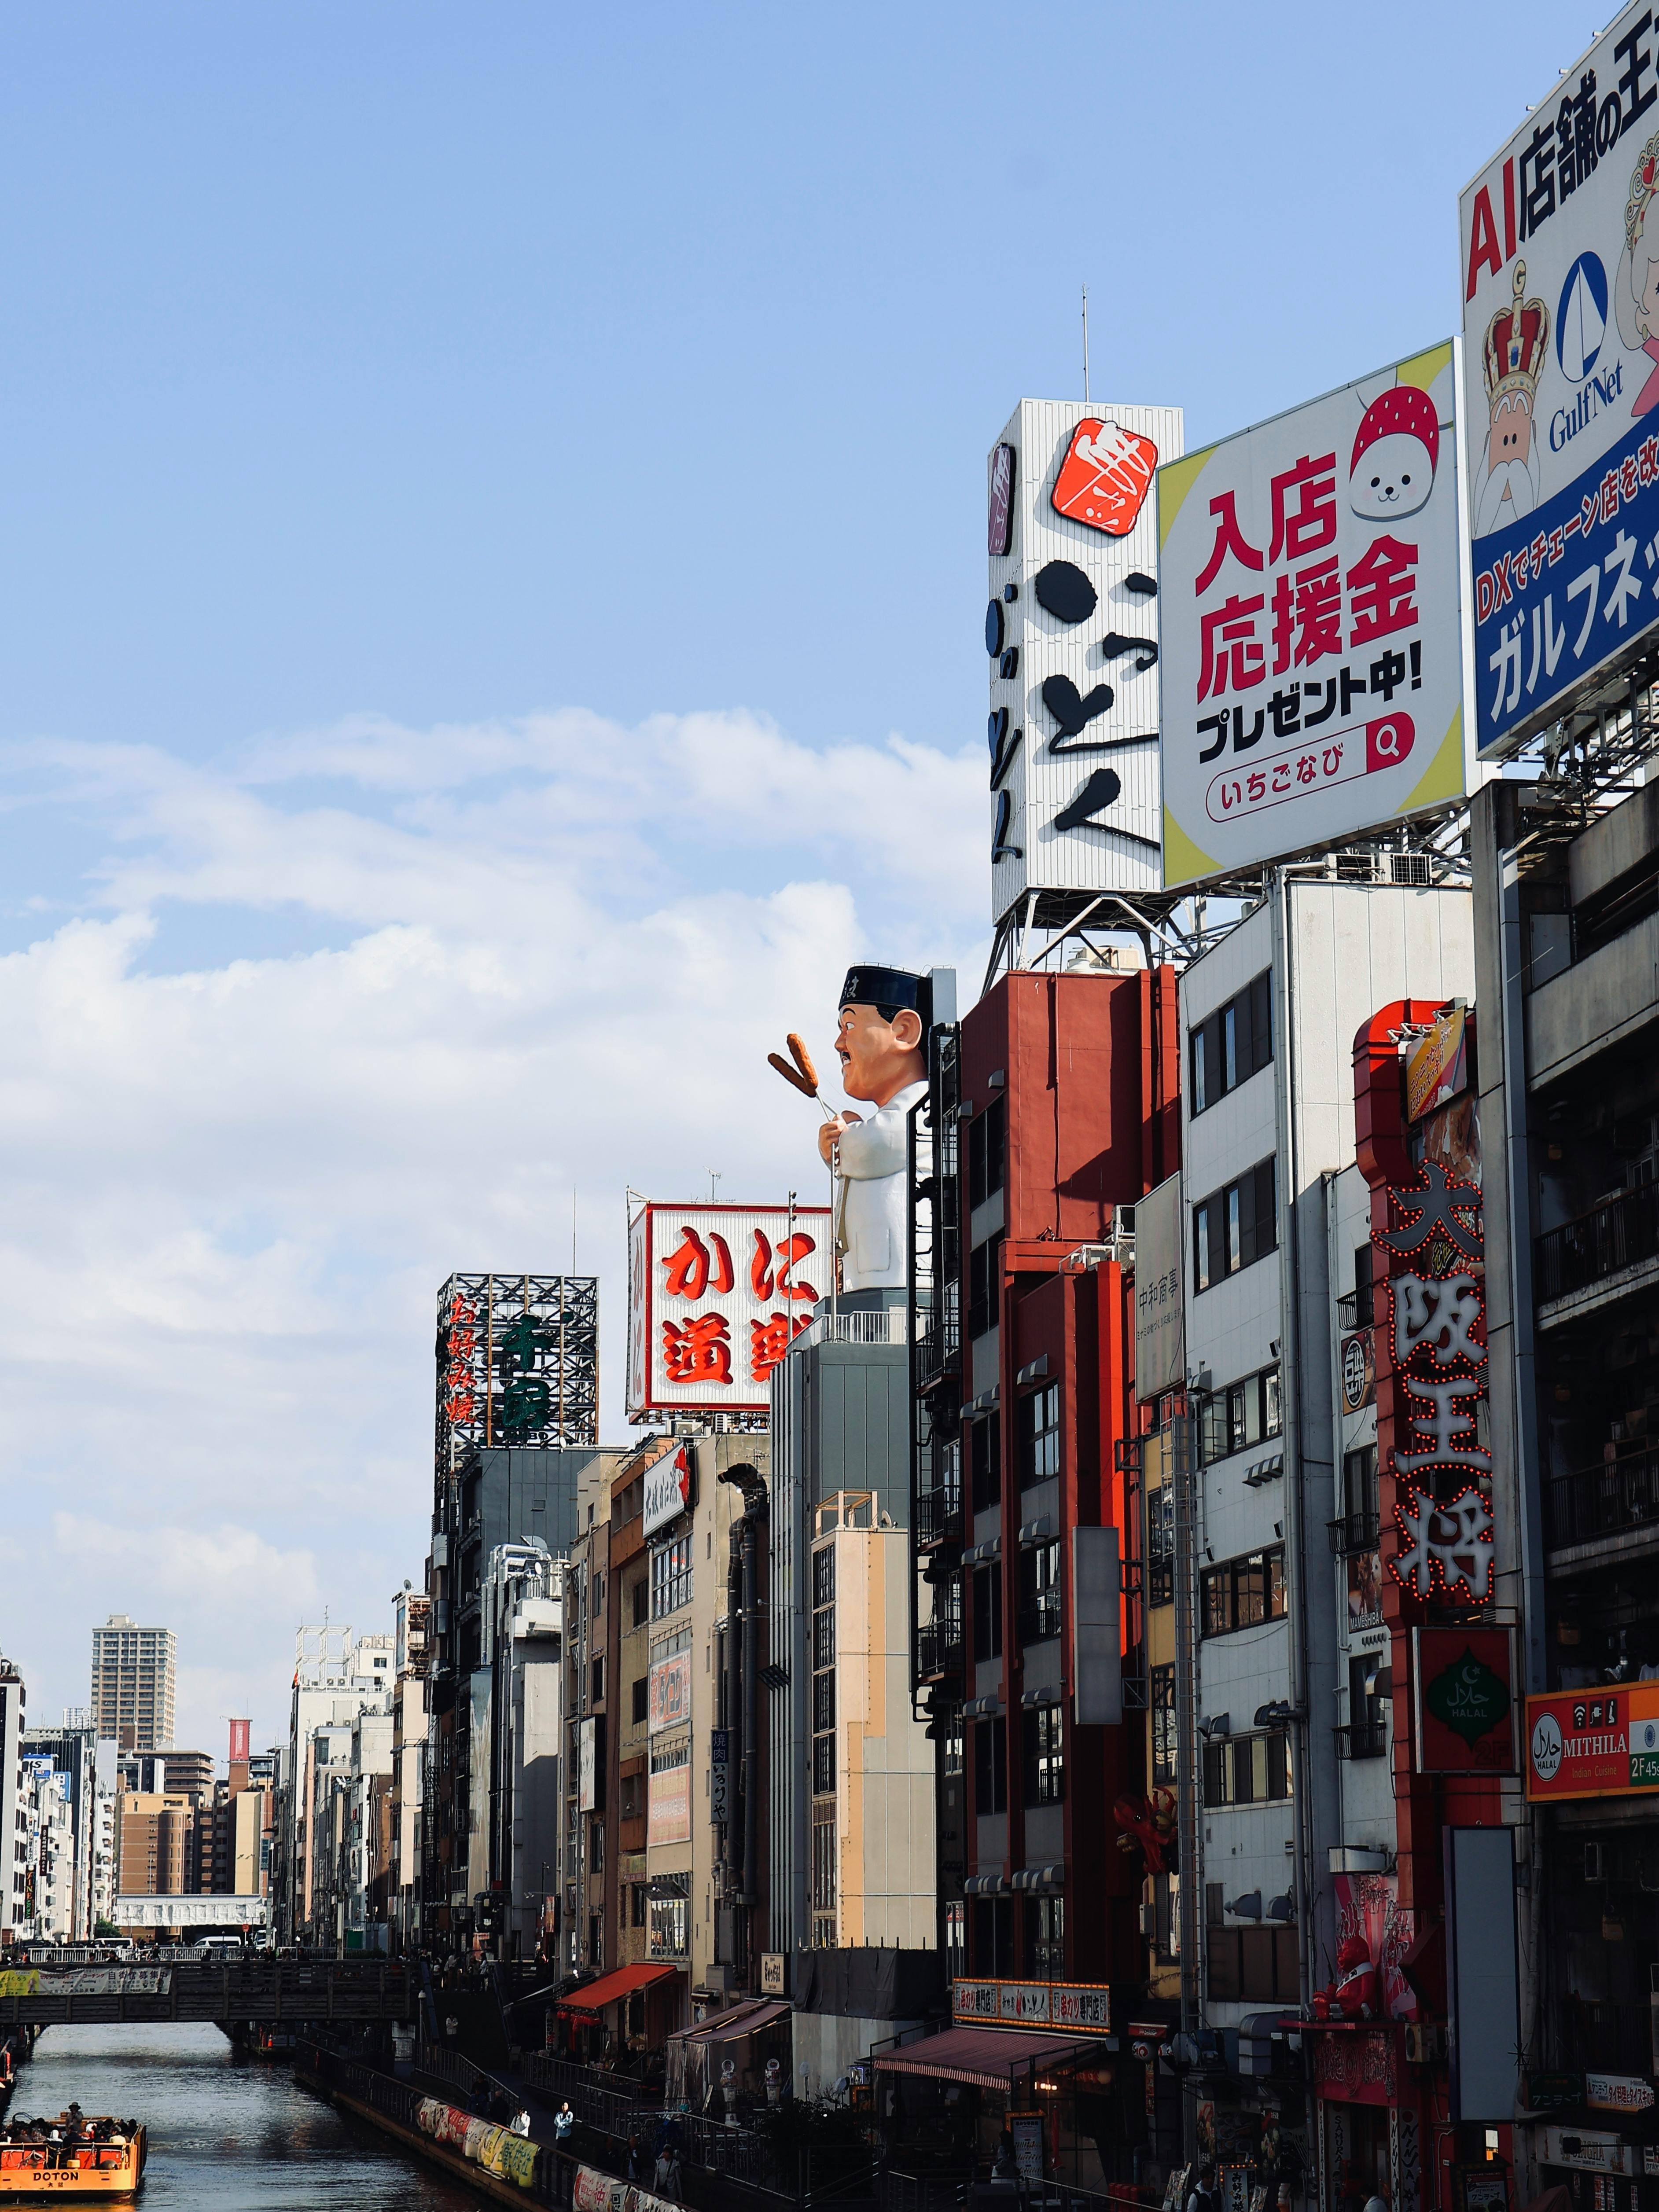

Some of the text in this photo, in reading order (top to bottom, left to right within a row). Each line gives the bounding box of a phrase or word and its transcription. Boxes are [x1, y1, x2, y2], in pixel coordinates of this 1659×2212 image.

[1466, 9, 1659, 303] AI店舗の王
[1195, 450, 1338, 598] 入店
[1197, 534, 1419, 705] 応援金
[1221, 742, 1344, 810] いちごなび
[661, 1226, 819, 1302] かに
[1139, 1268, 1178, 1316] 中和商事
[446, 1293, 477, 1423] お好み焼
[502, 1314, 554, 1428] 千房
[1379, 1162, 1494, 1598] 大阪王将
[1350, 1611, 1379, 1629] MAMESHIBA
[1452, 1709, 1488, 1717] HALAL
[1475, 1740, 1510, 1765] 2F
[1563, 1733, 1627, 1758] MITHILA
[713, 1734, 726, 1820] 焼肉 いろりや
[1538, 1760, 1557, 1770] HALAL
[1572, 1766, 1617, 1778] Indian Cuisine
[1631, 1758, 1645, 1777] 2F
[960, 1988, 991, 2012] 串カツ専門店
[1061, 1993, 1100, 2021] 串カツ専門店
[1402, 2123, 1419, 2180] NINJA
[1572, 2140, 1605, 2161] INGHA
[33, 2172, 78, 2181] DOTON
